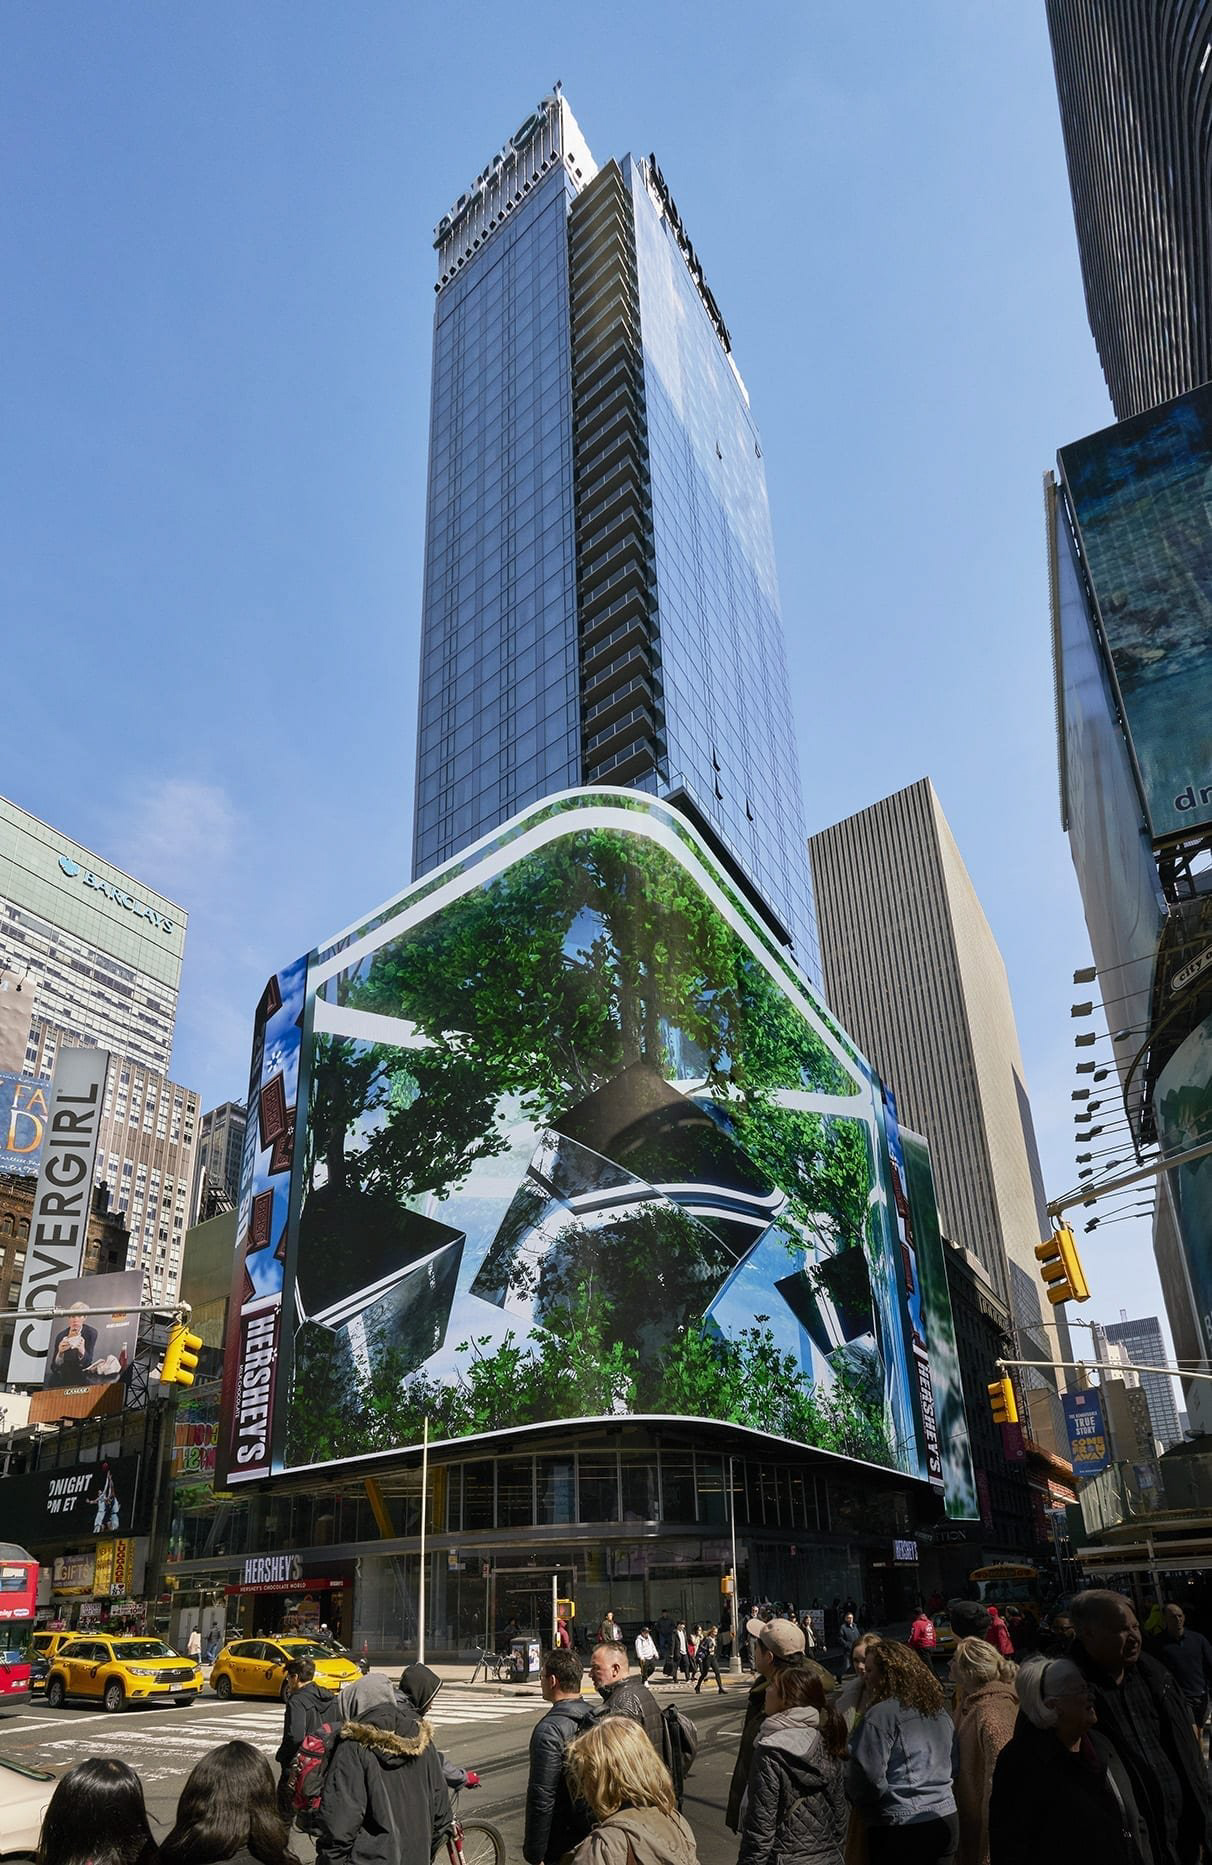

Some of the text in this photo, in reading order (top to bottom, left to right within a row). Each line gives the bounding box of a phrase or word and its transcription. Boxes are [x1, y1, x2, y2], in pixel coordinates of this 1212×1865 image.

[82, 868, 174, 935] BARCLAYS
[1179, 958, 1203, 982] city
[19, 1083, 98, 1358] COVERGIRL
[237, 1313, 275, 1464] HERSHEY'S
[917, 1361, 941, 1473] HERSHEY'S
[1074, 1417, 1096, 1427] TRUE
[1076, 1426, 1096, 1435] STORY
[62, 1497, 77, 1512] ET
[61, 1564, 90, 1581] GIFTS
[115, 1540, 126, 1583] LUGGAGE
[244, 1554, 304, 1584] HERSHEY'S
[263, 1583, 289, 1591] CHOCOLATE
